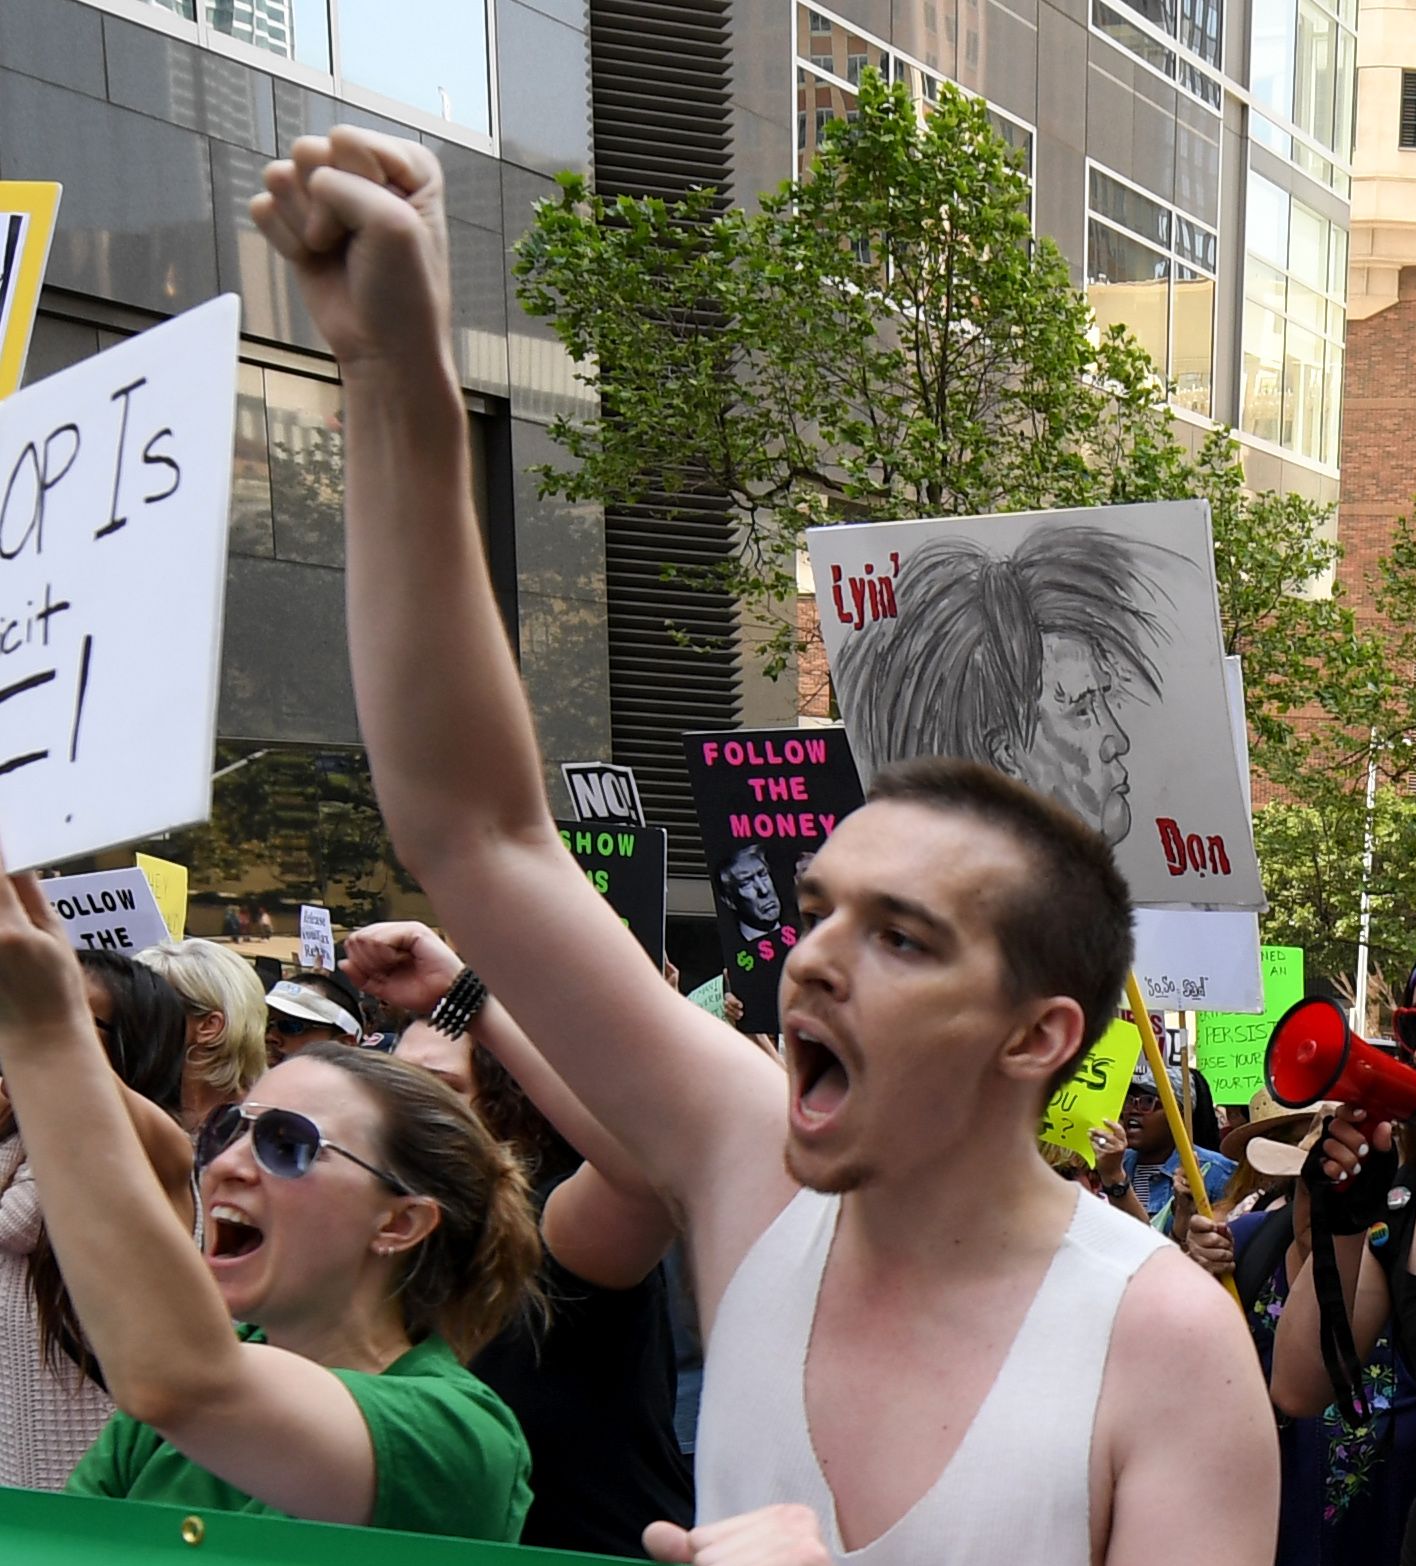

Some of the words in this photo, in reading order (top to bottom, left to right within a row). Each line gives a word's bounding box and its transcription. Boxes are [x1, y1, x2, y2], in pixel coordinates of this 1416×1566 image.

[93, 376, 182, 542] Is
[703, 739, 827, 767] FOLLOW
[571, 772, 638, 821] NO!
[748, 776, 809, 802] THE
[730, 813, 836, 838] MONEY
[559, 830, 635, 858] SHOW
[1156, 817, 1232, 878] Don
[51, 888, 136, 920] OLLOW
[80, 927, 134, 950] THE
